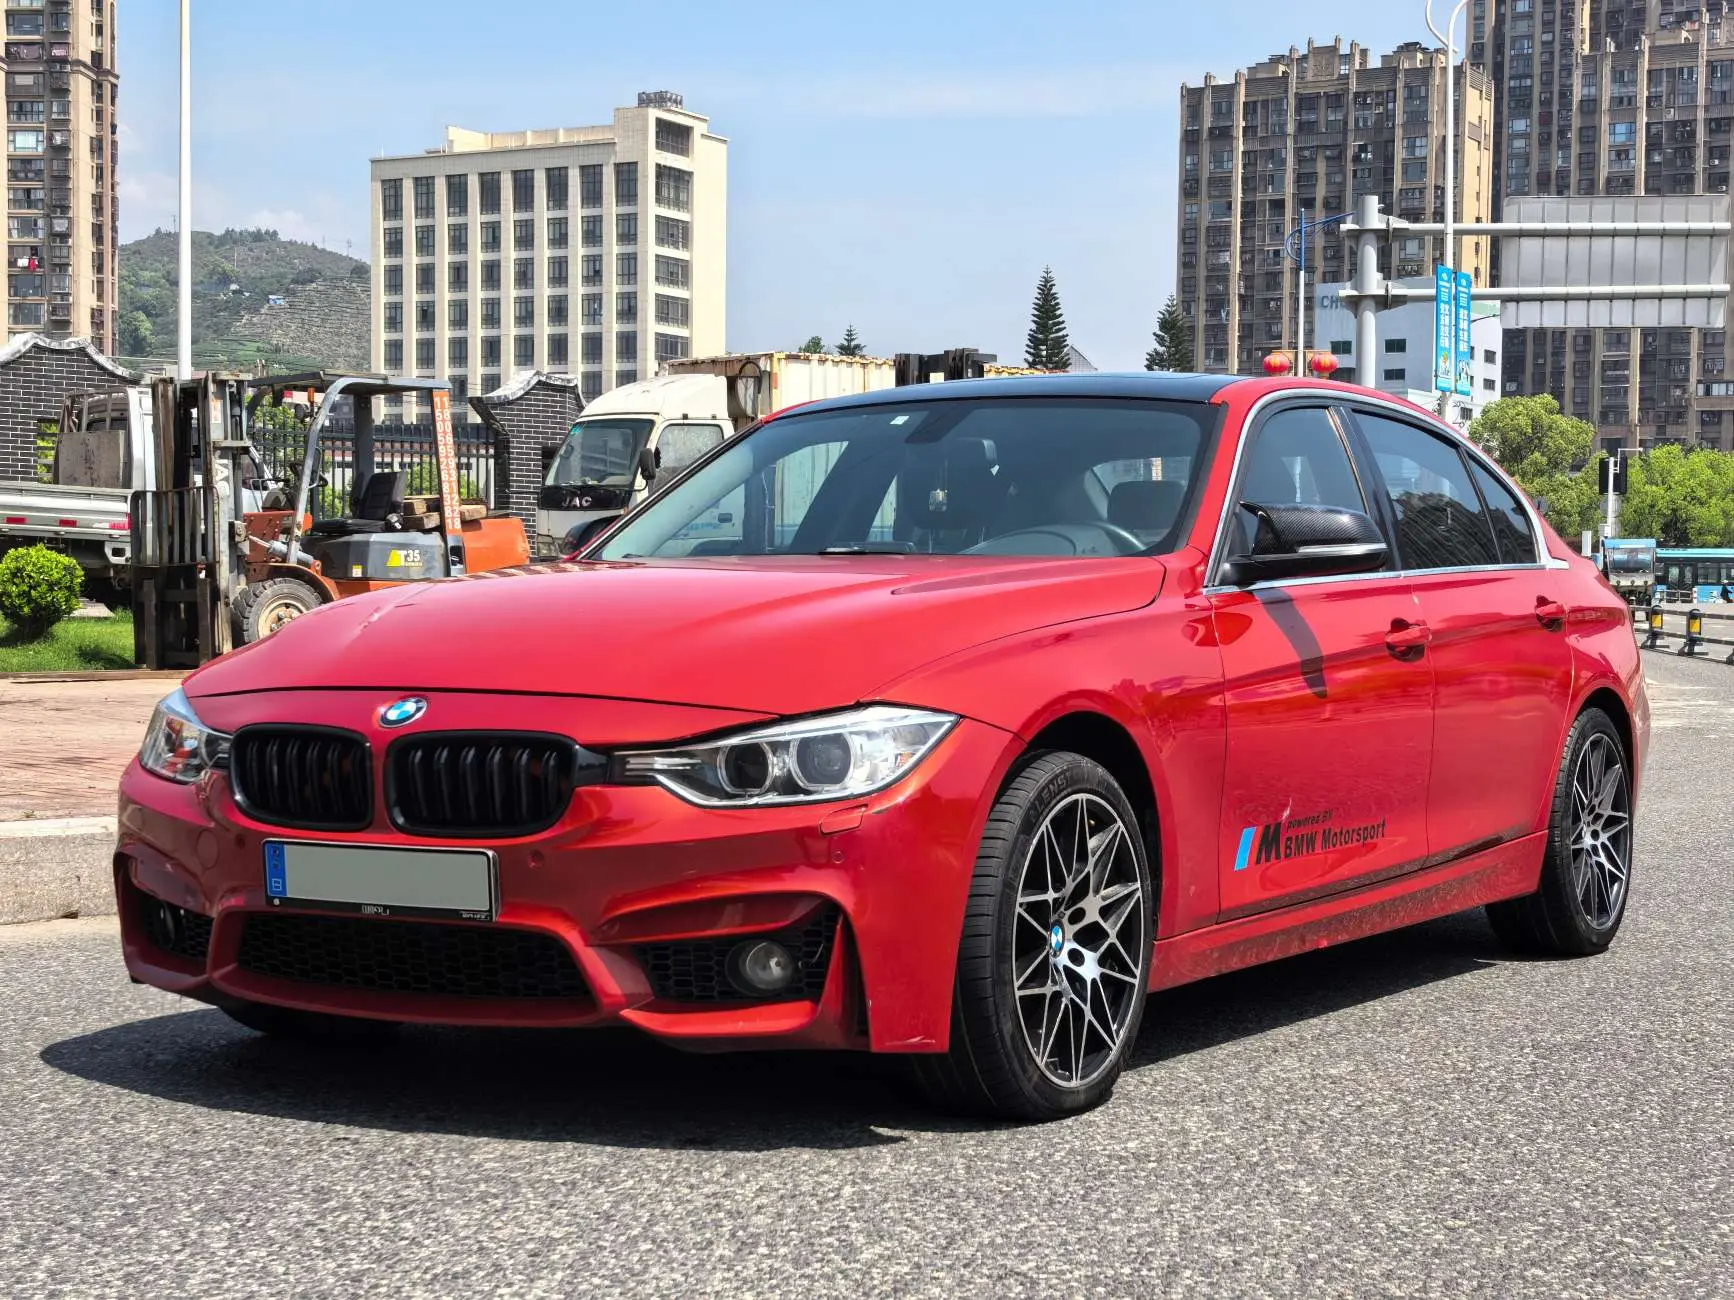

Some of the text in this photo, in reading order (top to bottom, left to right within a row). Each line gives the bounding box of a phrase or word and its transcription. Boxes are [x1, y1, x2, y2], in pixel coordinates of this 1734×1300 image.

[1321, 295, 1347, 310] CH
[562, 496, 592, 508] JAC
[397, 549, 420, 566] T35
[1255, 821, 1283, 865] M
[1284, 819, 1386, 859] BMW Motorsport
